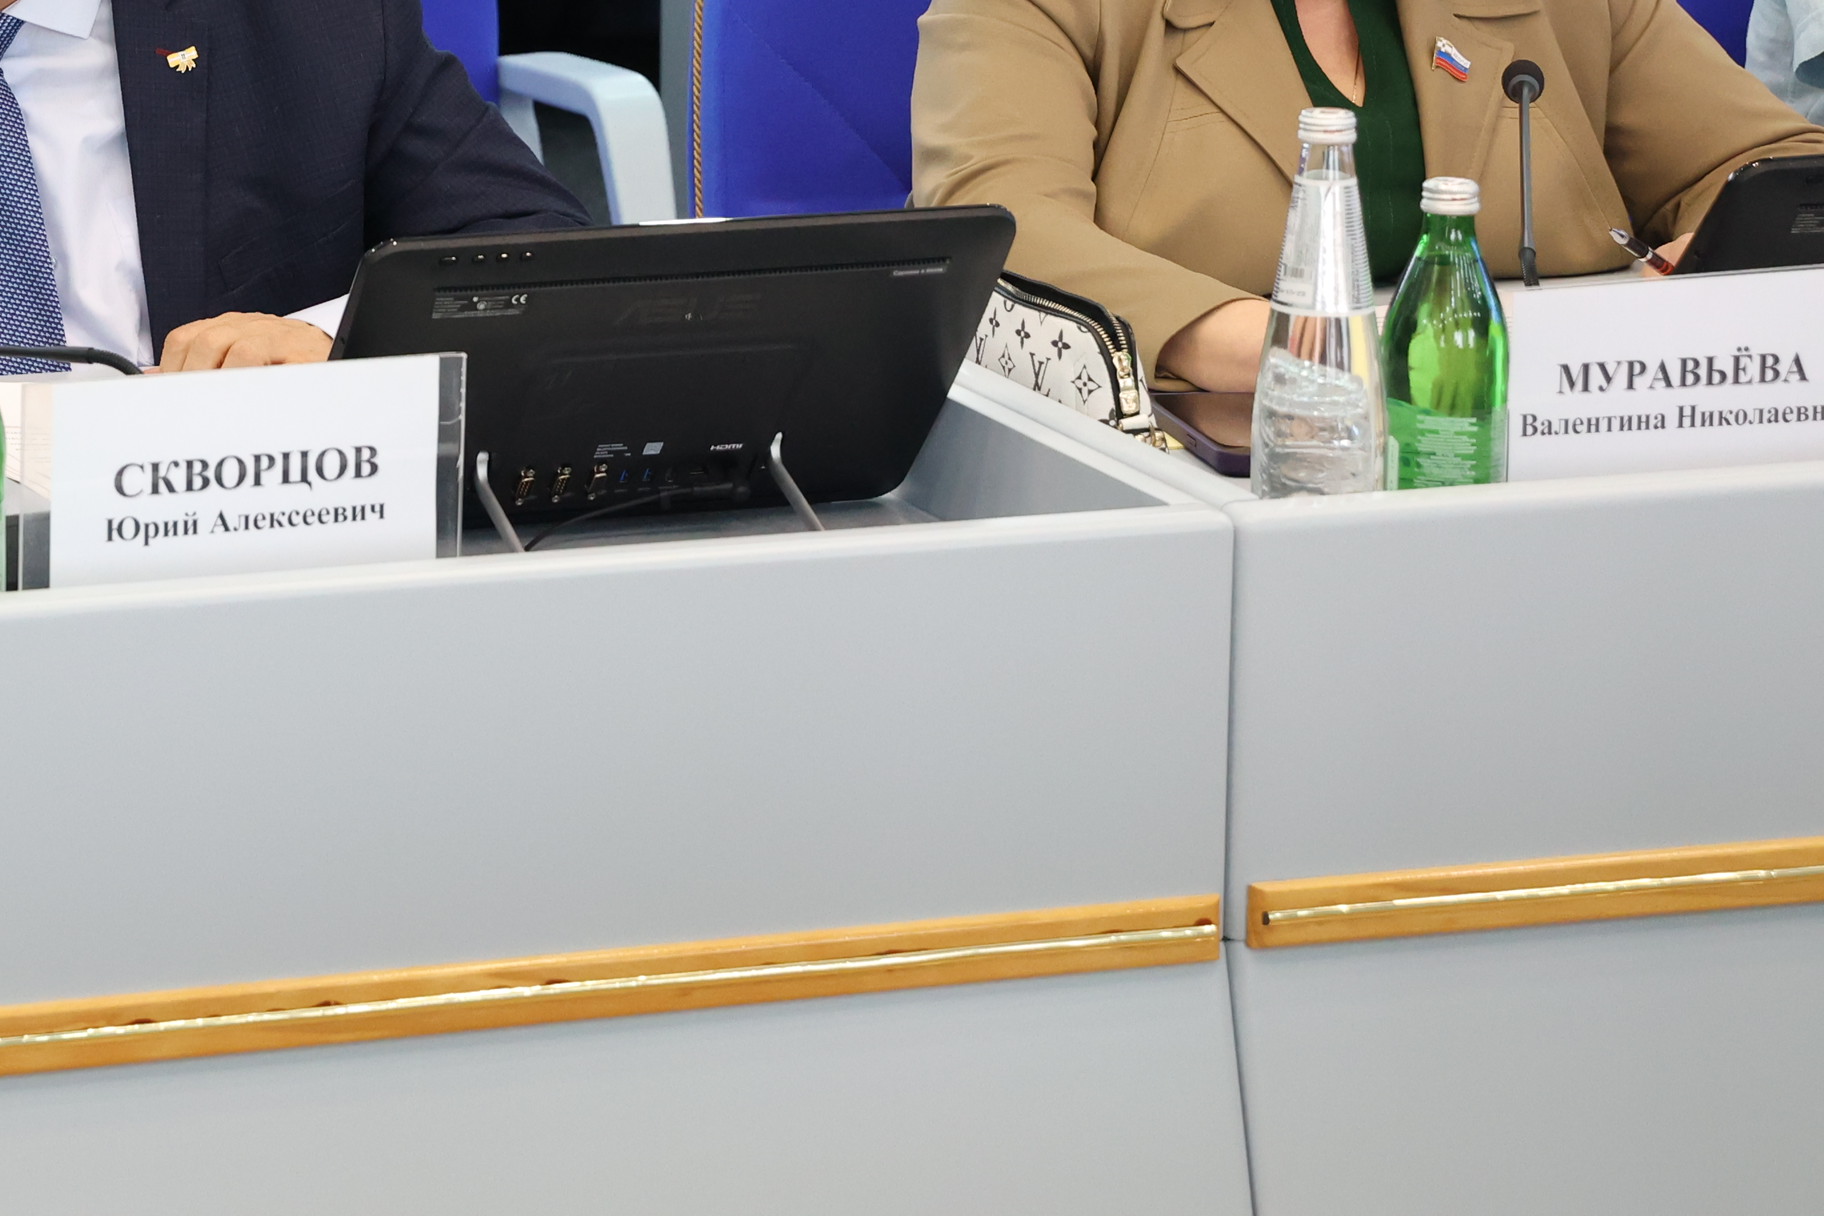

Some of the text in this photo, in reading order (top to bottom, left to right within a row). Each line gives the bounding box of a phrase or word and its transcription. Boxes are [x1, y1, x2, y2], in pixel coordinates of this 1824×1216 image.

[1556, 345, 1810, 395] МУРАВЬЁВА
[709, 442, 744, 452] HDMI
[1519, 411, 1667, 438] Валентина
[113, 445, 380, 498] СКВОРЦОВ
[104, 502, 386, 547] Юрий Алексеевич
